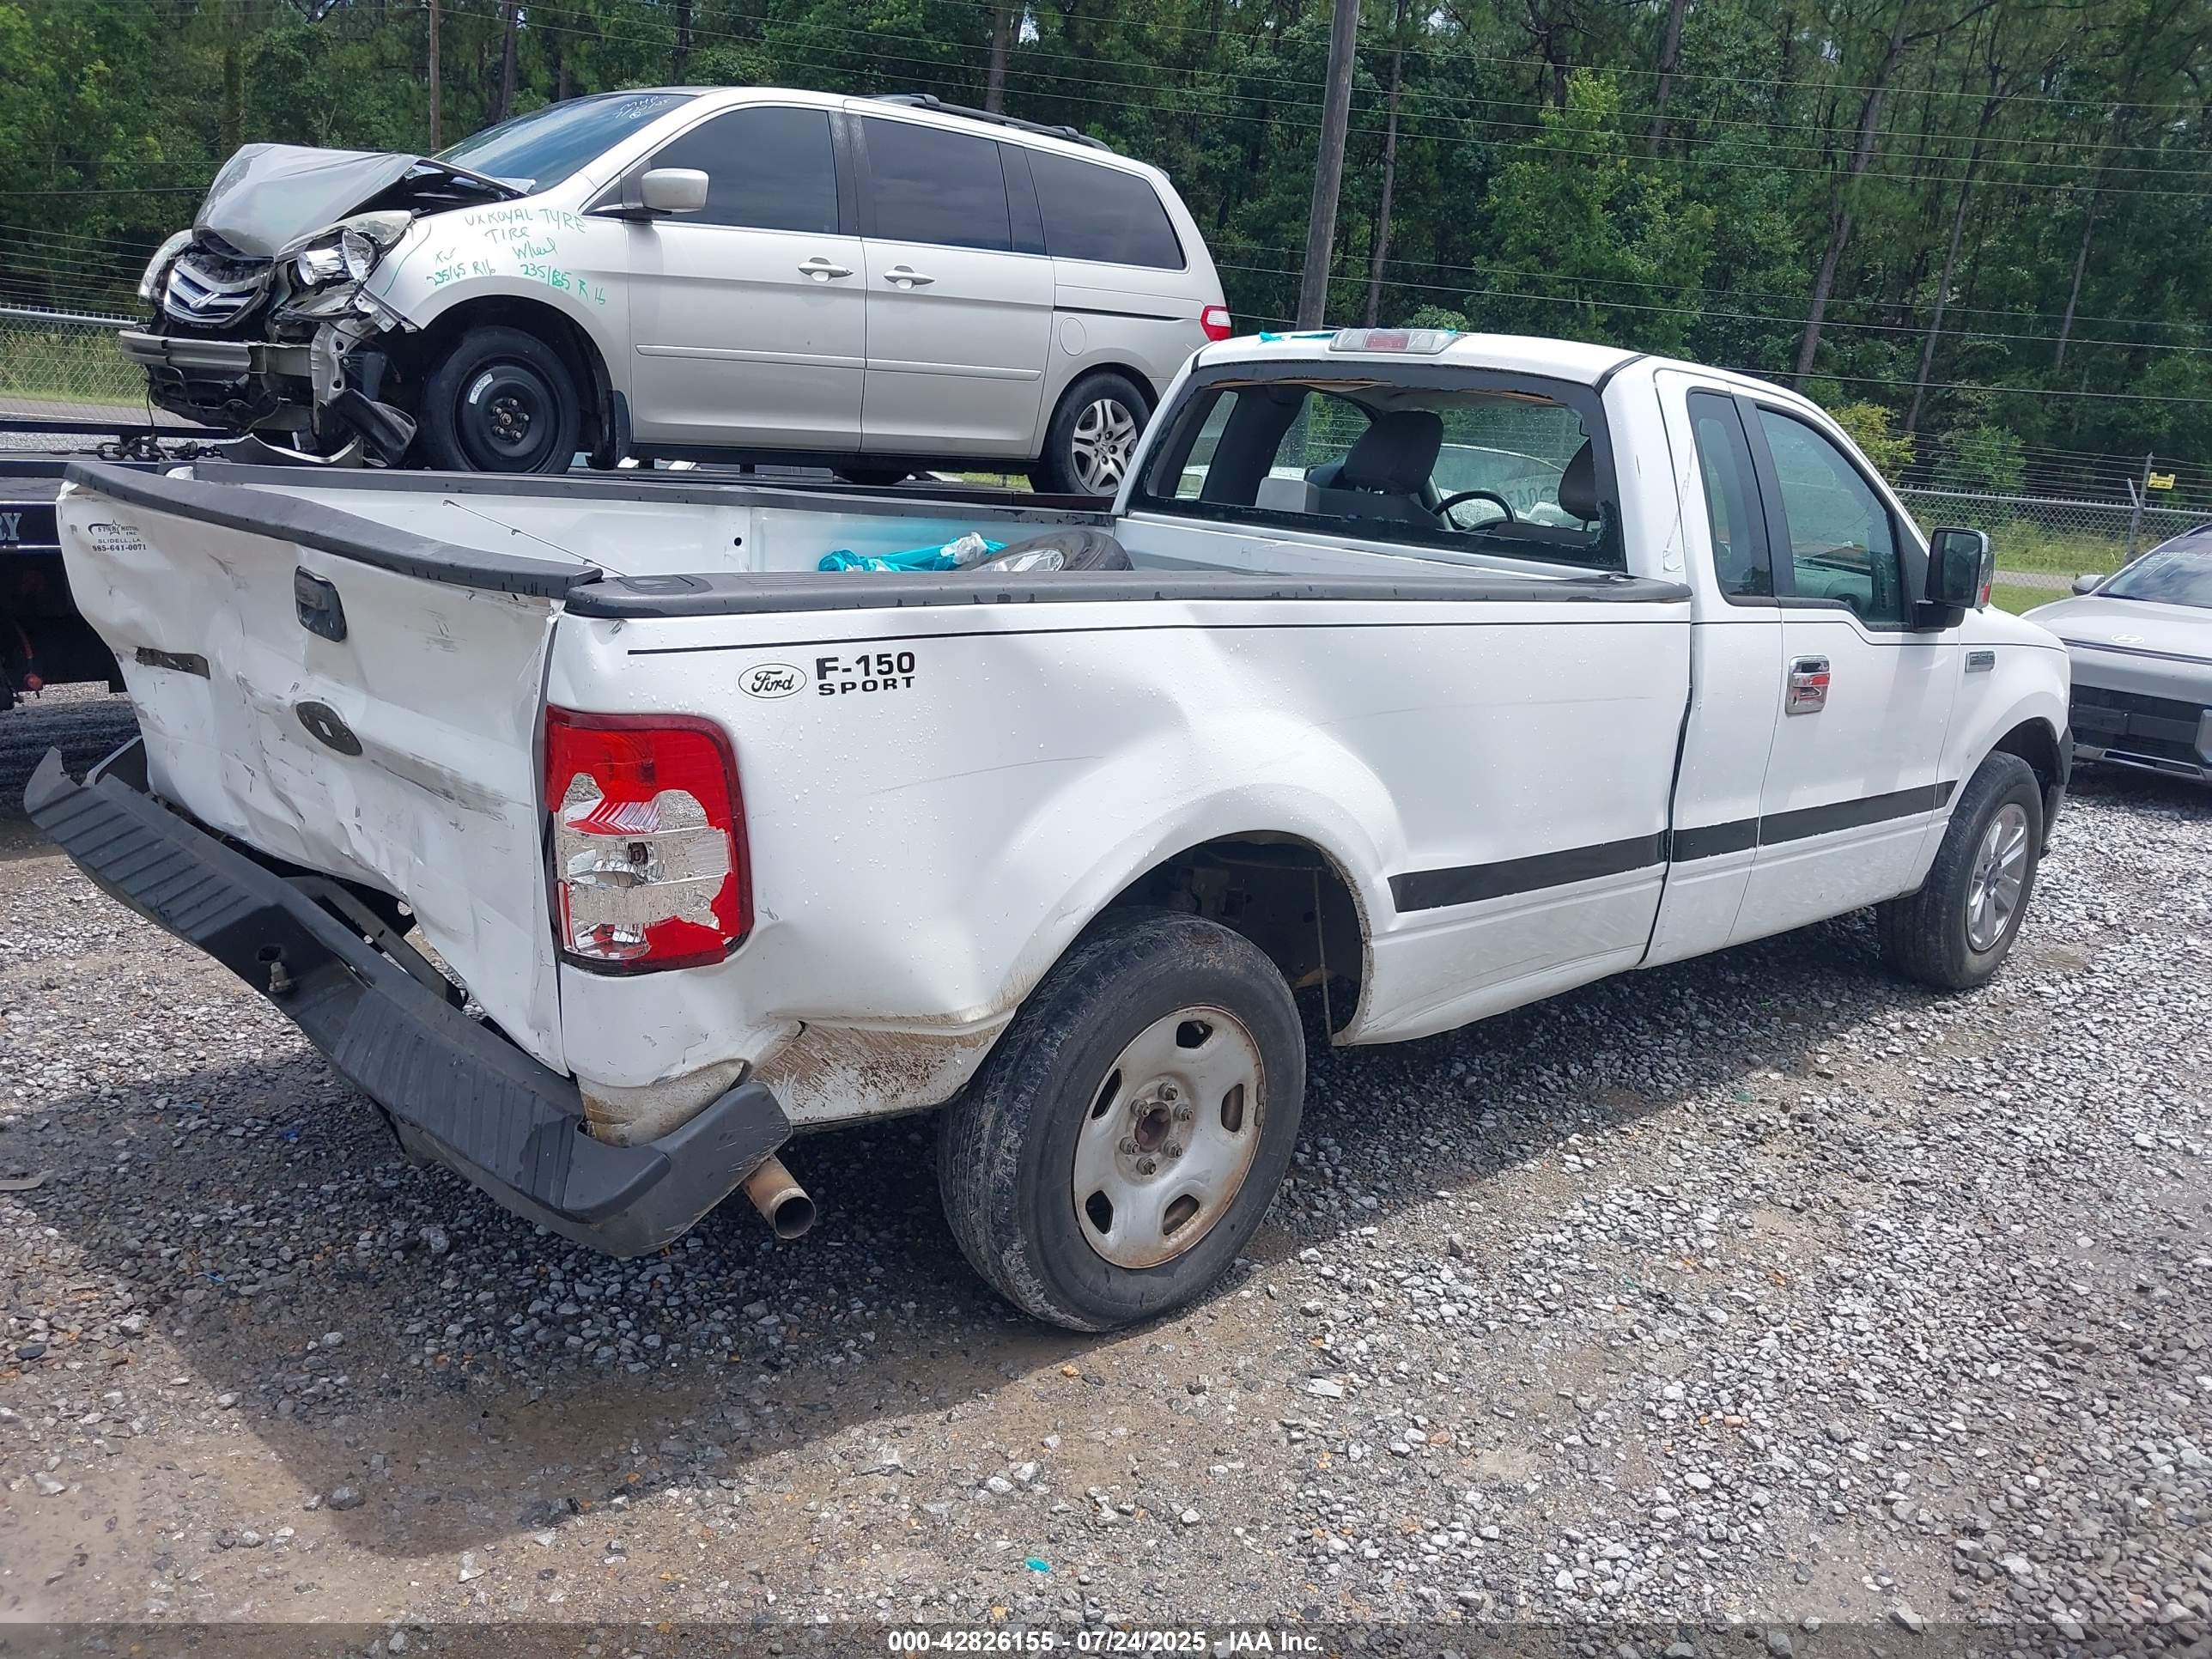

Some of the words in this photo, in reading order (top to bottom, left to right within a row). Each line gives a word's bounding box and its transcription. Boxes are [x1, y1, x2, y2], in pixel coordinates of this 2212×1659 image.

[538, 209, 586, 234] TYRE
[92, 544, 147, 552] 985-641-0071
[816, 652, 915, 680] F-150
[750, 670, 794, 693] Ford
[818, 676, 915, 696] SPORT
